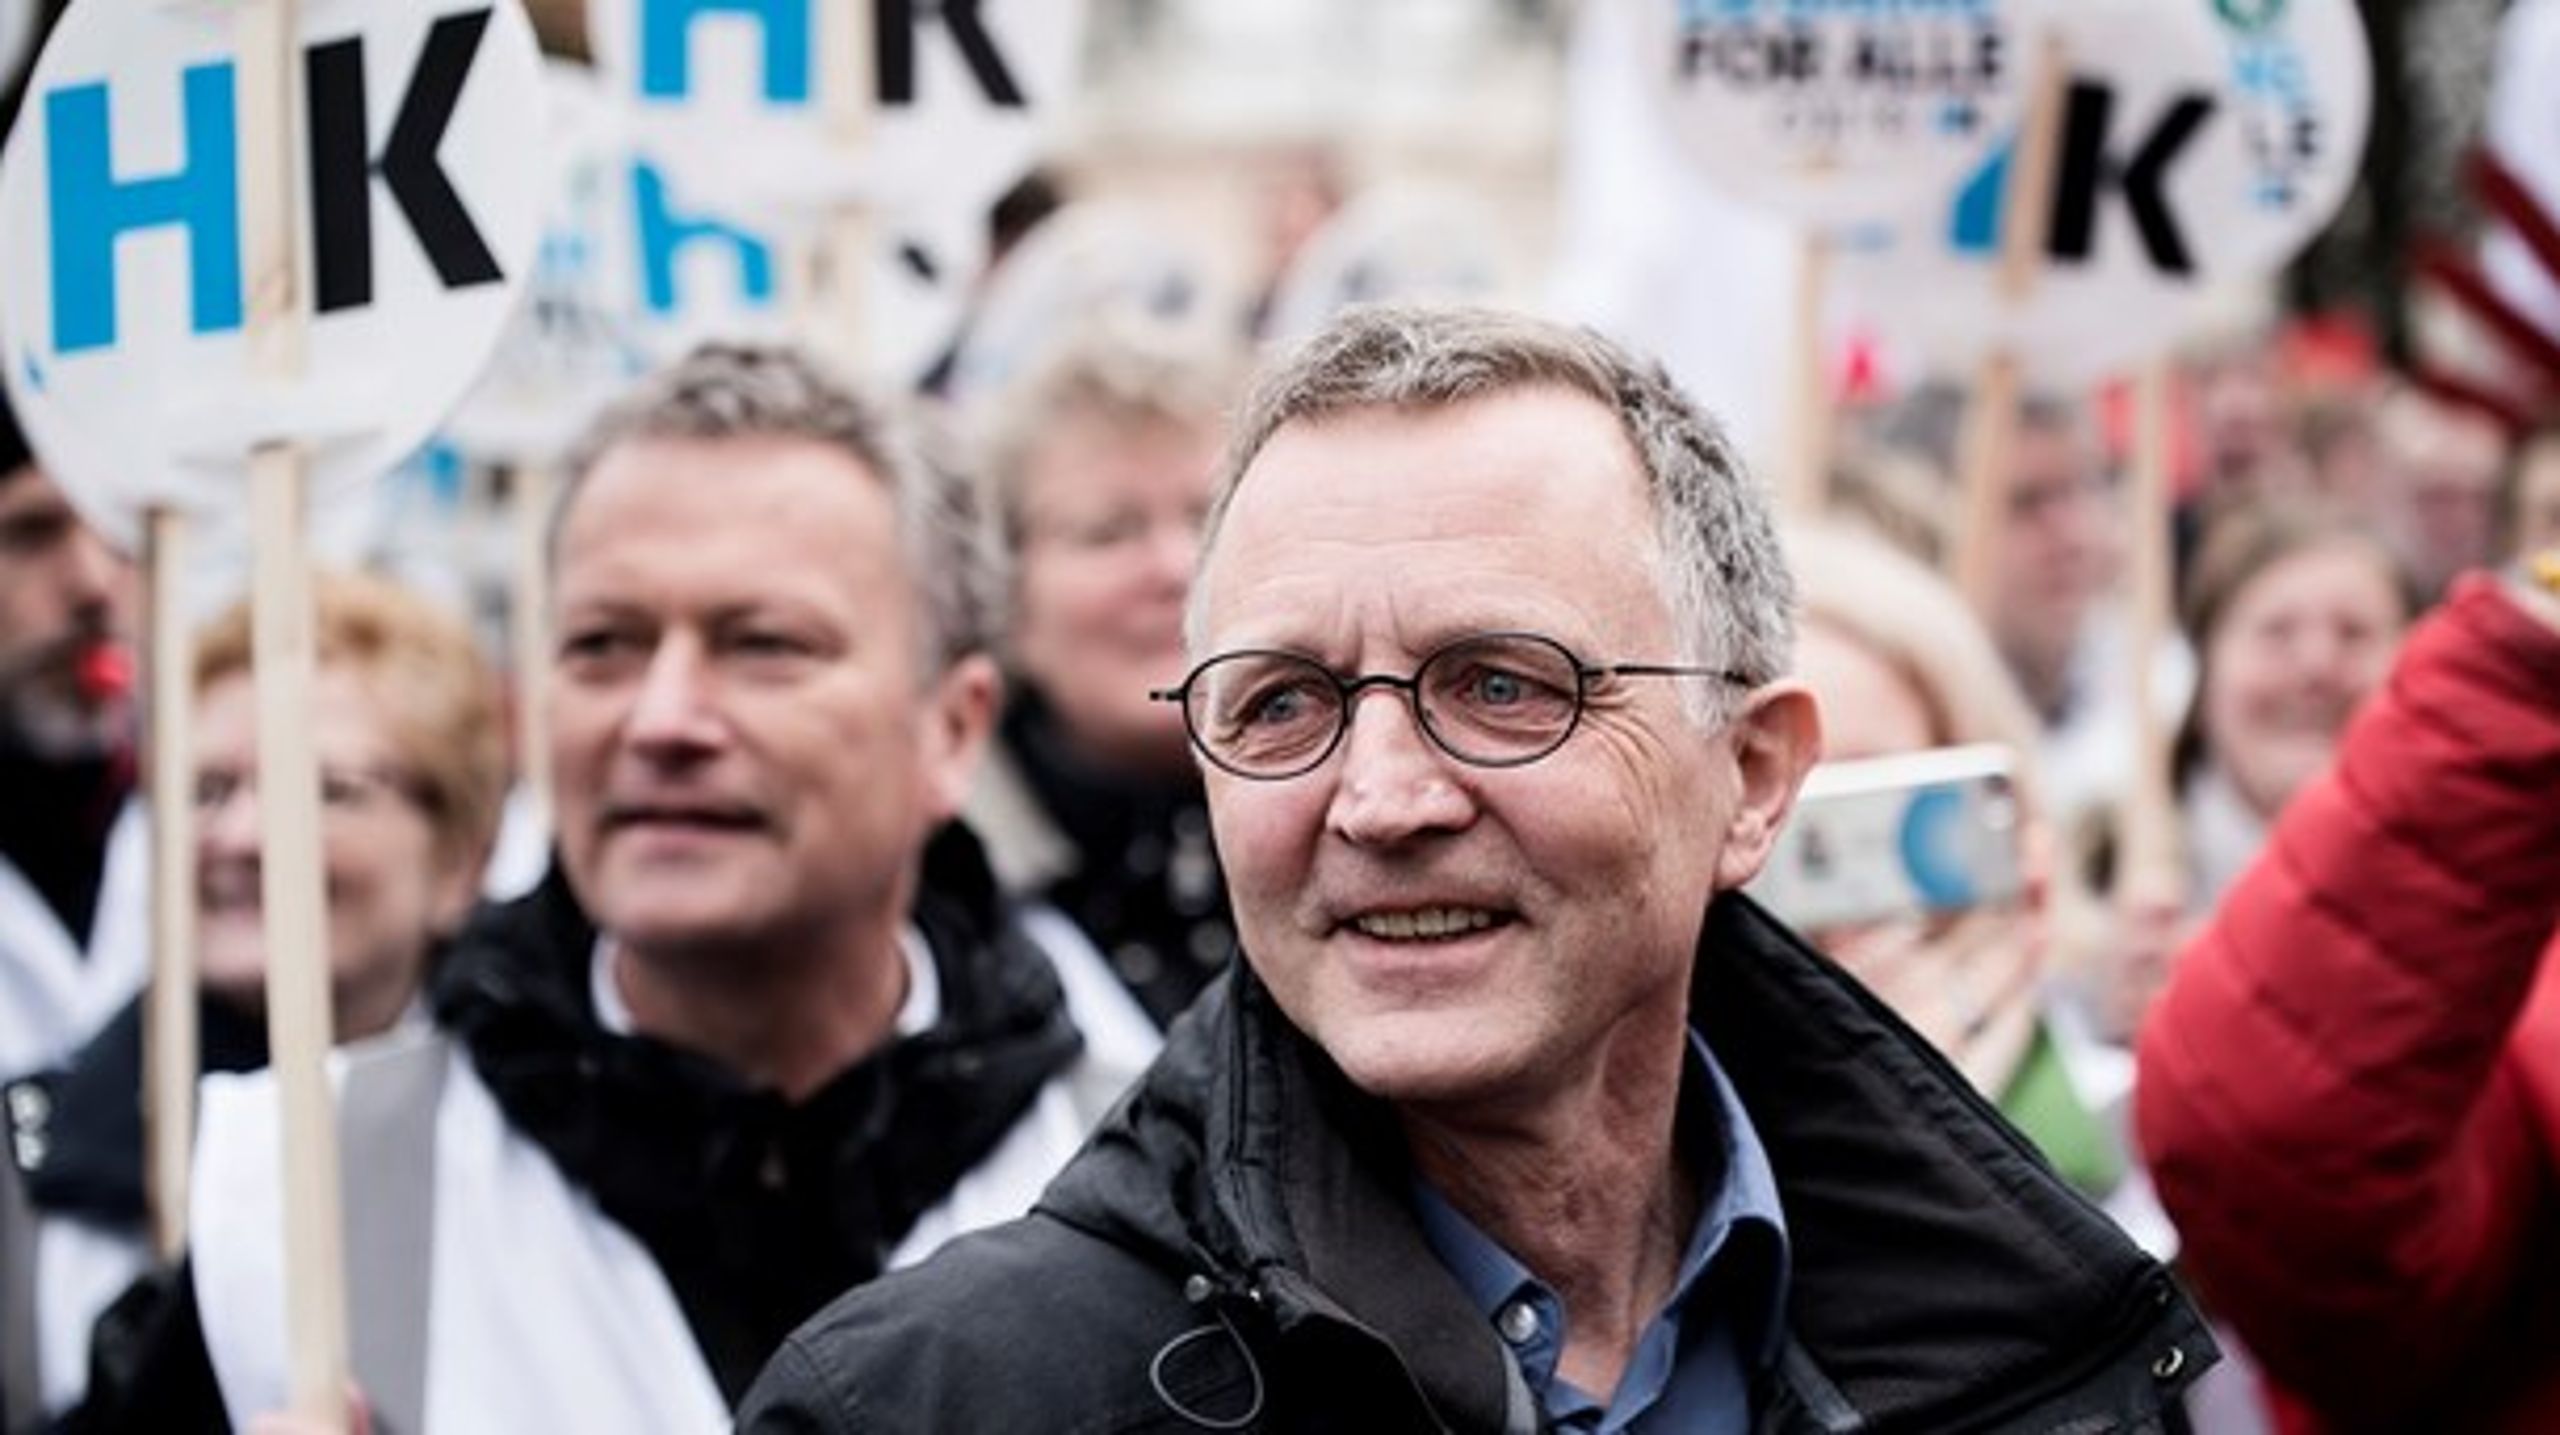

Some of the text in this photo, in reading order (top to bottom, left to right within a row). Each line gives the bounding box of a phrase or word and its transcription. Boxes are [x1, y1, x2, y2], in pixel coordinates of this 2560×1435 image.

[1678, 36, 2004, 88] FOR ALLE
[44, 6, 506, 354] HK
